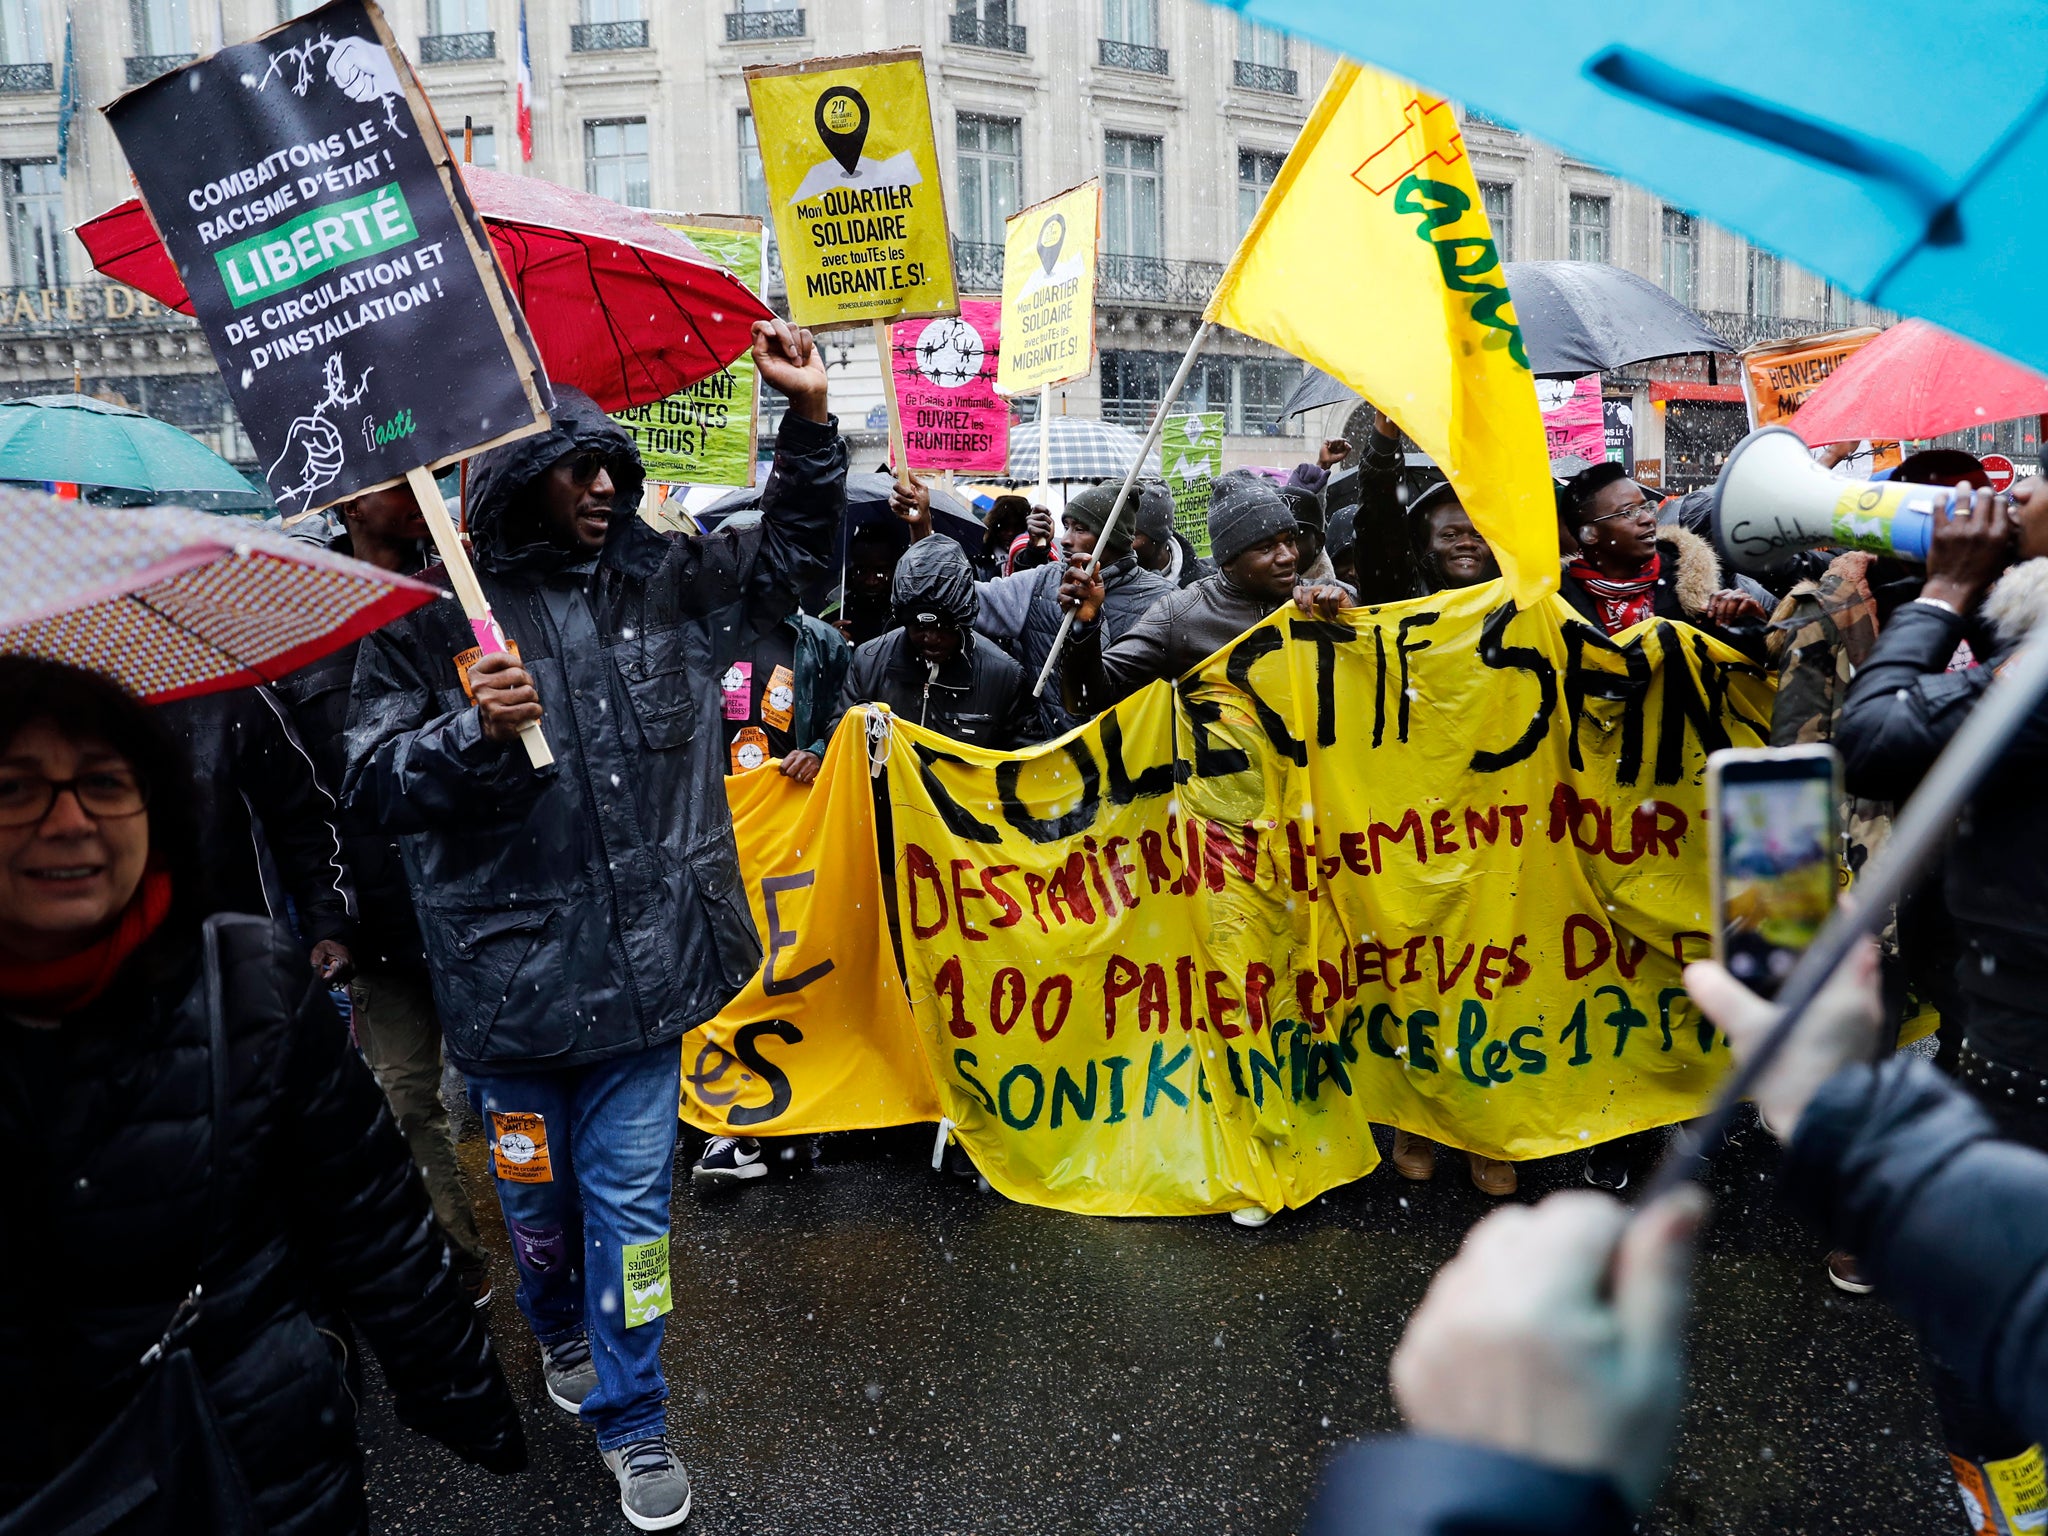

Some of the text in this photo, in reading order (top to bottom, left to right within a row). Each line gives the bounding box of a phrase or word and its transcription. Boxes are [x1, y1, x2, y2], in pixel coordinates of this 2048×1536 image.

[188, 119, 379, 212] COMBATTONS LE
[197, 184, 297, 245] RACISME
[297, 152, 381, 200] D'ÉTAT
[797, 184, 914, 220] Mon QUARTIER
[225, 188, 408, 297] LIBERTÉ
[812, 215, 907, 247] SOLIDAIRE
[822, 246, 905, 267] avec touTEs les
[224, 242, 445, 346] DE CIRCULATION ET
[806, 262, 926, 298] MIGRANT.E.S!
[1017, 276, 1079, 314] Mon QUARTIER
[250, 283, 431, 370] D'INSTALLATION
[1022, 300, 1073, 334] SOLIDAIRE
[1012, 336, 1078, 372] MIGRANT.E.S!
[1024, 336, 1040, 349] avec
[1061, 325, 1070, 337] les
[658, 399, 729, 429] TOUTES
[947, 395, 953, 407] à
[361, 408, 417, 452] fasti
[917, 409, 985, 431] OUVREZ les
[645, 427, 695, 455] TOUS
[907, 429, 993, 452] FRONTIÈRES!
[905, 843, 1023, 942] DES
[1549, 782, 1689, 866] POUR
[934, 954, 1073, 1043] 100
[1562, 913, 1648, 983] DU
[1457, 999, 1547, 1087] les
[1559, 985, 1648, 1066] 17
[628, 1260, 654, 1271] TOUTES
[640, 1247, 657, 1260] TOUS
